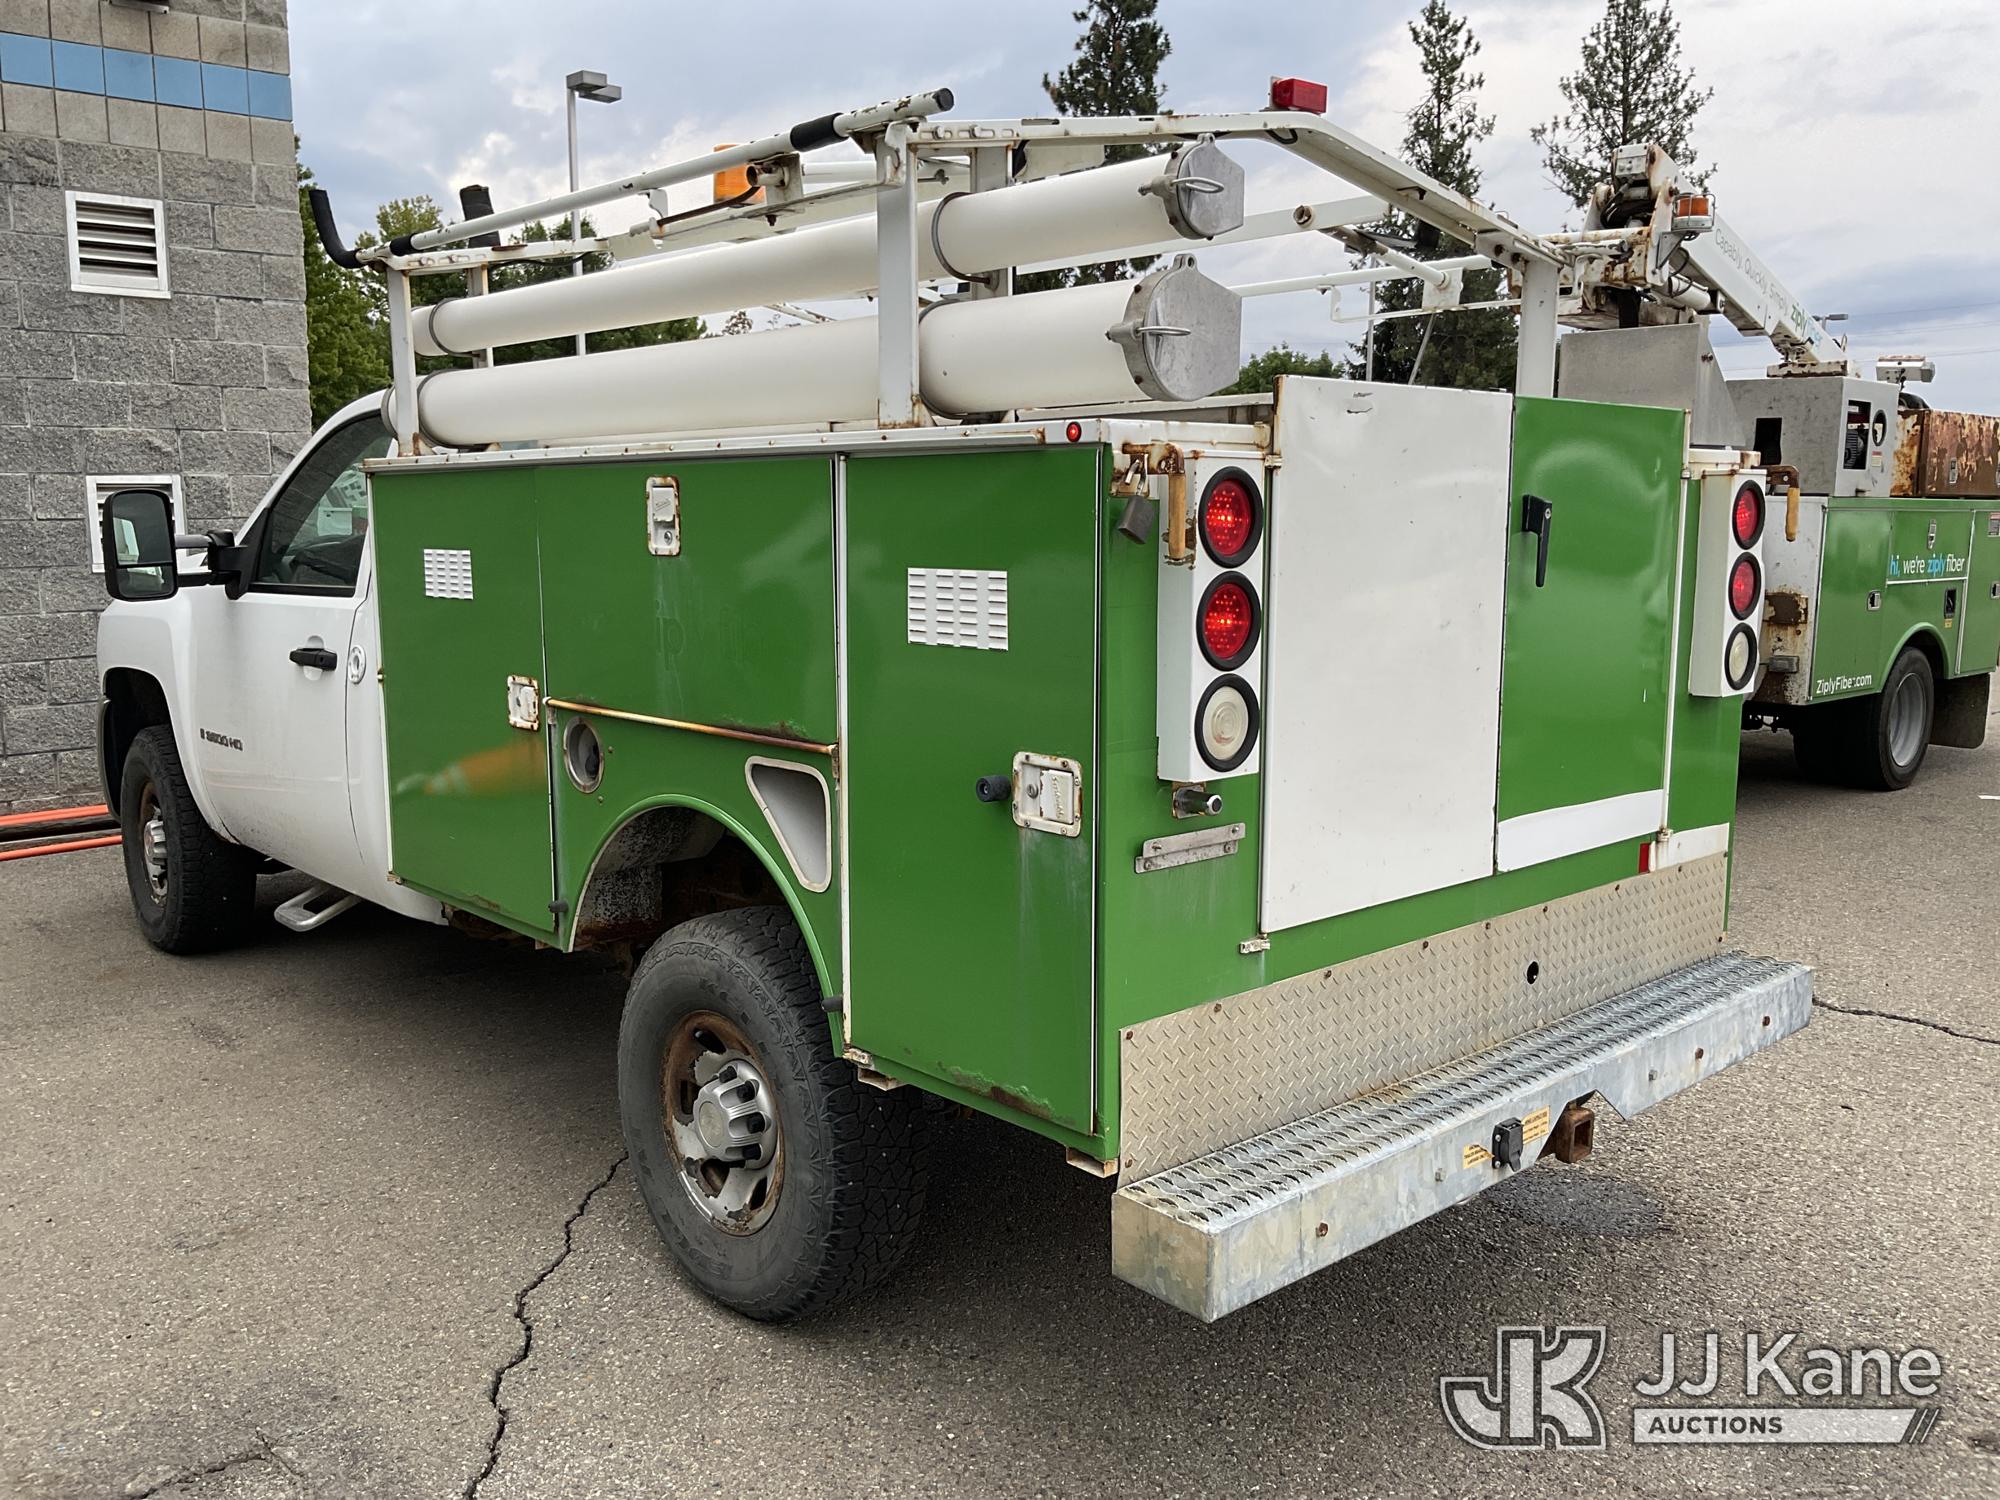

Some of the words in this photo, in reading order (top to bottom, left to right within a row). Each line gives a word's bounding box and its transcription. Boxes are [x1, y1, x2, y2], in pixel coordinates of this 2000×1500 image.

[1890, 554, 1900, 577] hi,
[1903, 555, 1925, 574] we're
[1927, 553, 1946, 576] ziply
[1946, 553, 1965, 572] fiber
